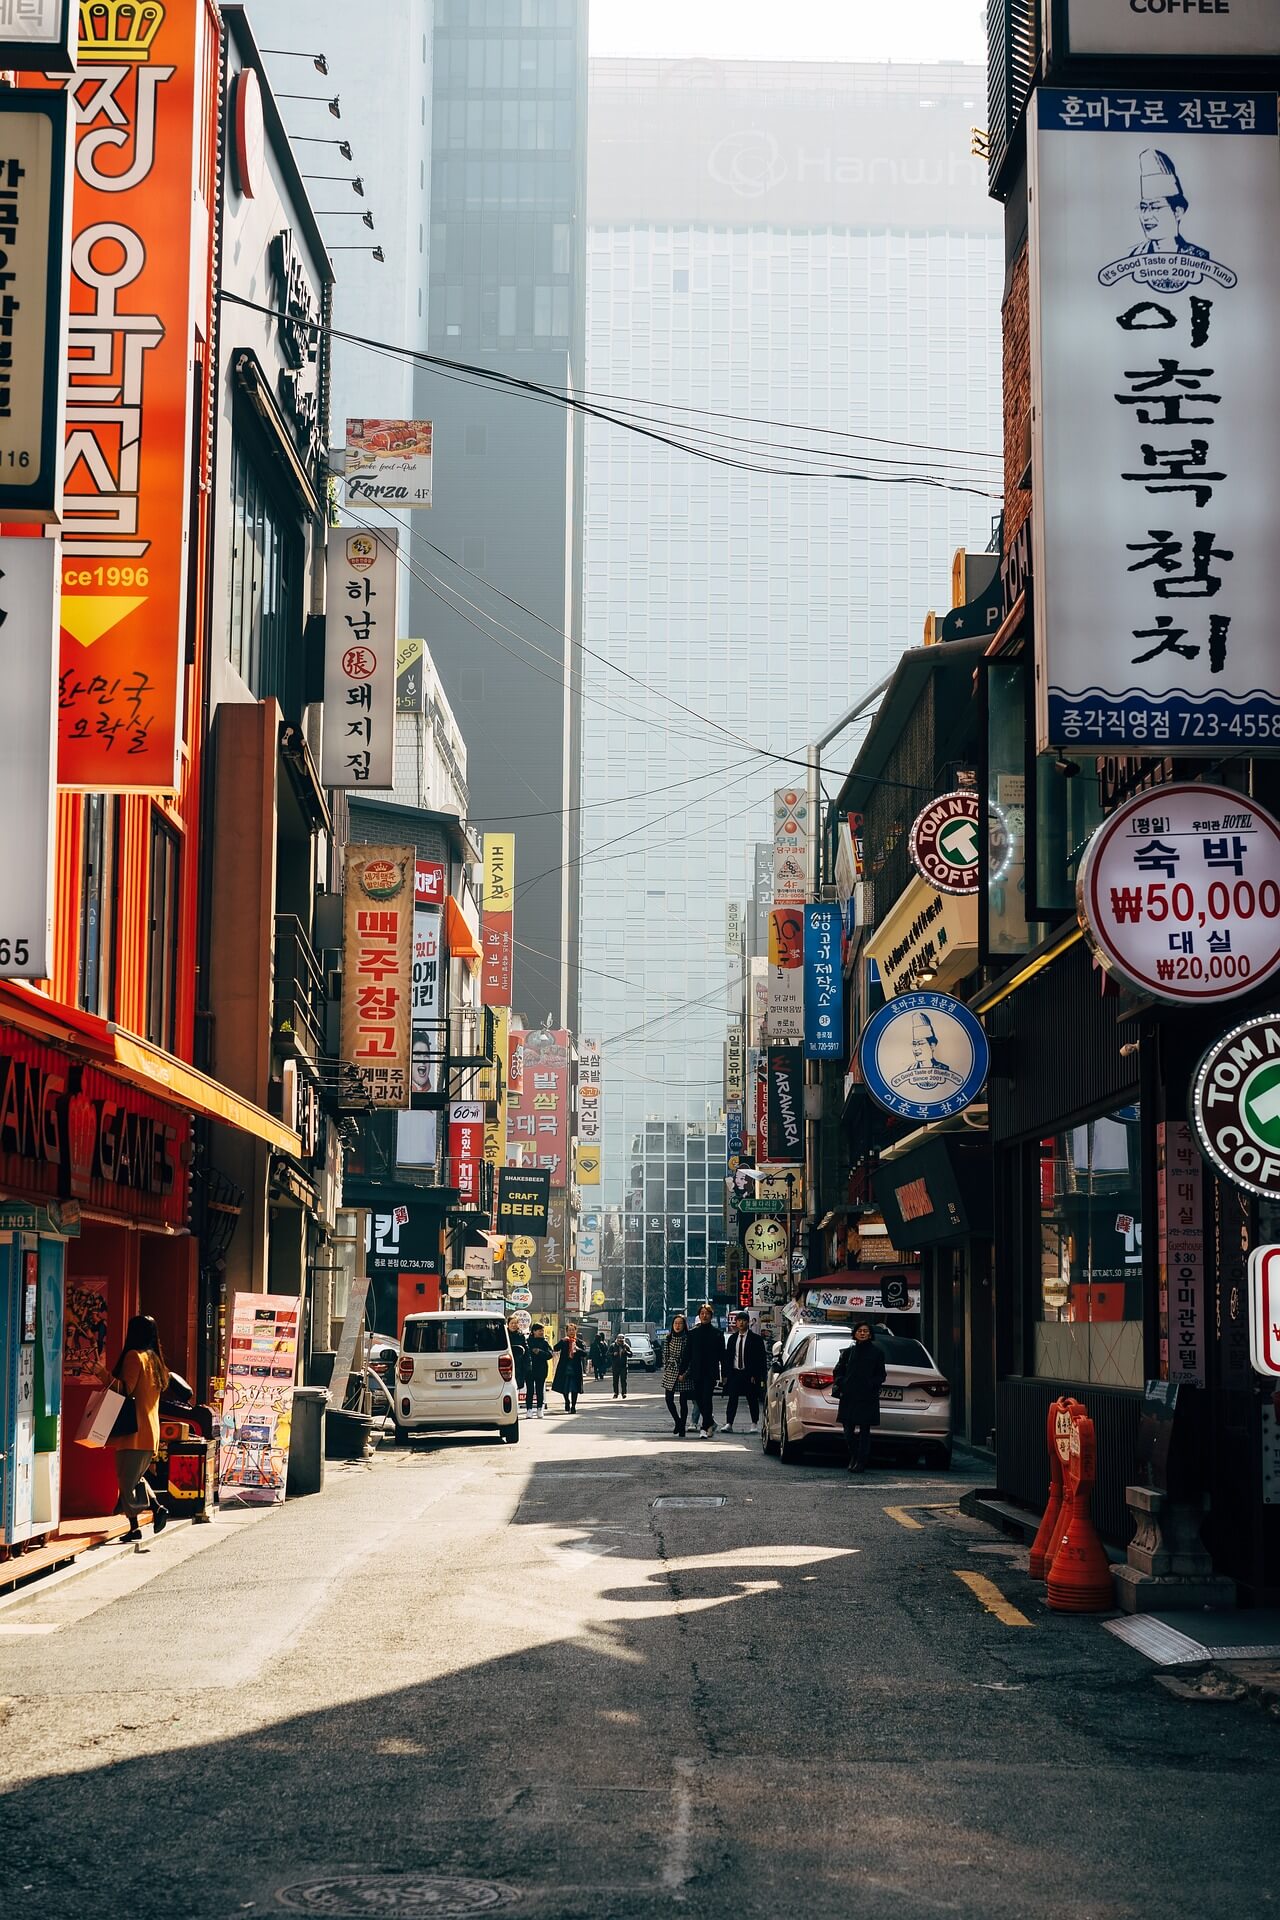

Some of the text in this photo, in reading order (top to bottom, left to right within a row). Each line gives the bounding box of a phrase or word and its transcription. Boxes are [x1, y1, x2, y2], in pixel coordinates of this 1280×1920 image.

[1130, 0, 1230, 14] COFFEE
[1058, 96, 1256, 130] 혼마구로 전문점
[797, 148, 987, 185] Hanwh
[1102, 256, 1232, 283] It's Good Taste of Bluefin Tuna
[1140, 268, 1196, 279] Since 2001
[379, 463, 395, 471] food
[349, 475, 429, 499] Forza 4F
[61, 567, 149, 587] ce1996
[68, 712, 154, 754] 오락실
[1061, 710, 1280, 739] 종각직영점 723-4558
[1192, 814, 1253, 831] 우미관 HOTEL
[364, 871, 396, 881] 세계맥주
[414, 941, 437, 958] 있다
[1156, 955, 1250, 983] ₩20,000
[355, 910, 401, 1058] 맥주창고
[890, 997, 957, 1013] 혼마구로 전문점
[579, 1055, 600, 1067] 보쌈
[728, 1035, 741, 1087] 일본유학
[357, 1068, 404, 1083] 계맥주
[579, 1070, 600, 1083] 족발
[581, 1098, 600, 1136] 보신탕
[99, 1100, 177, 1196] GAMES
[461, 1127, 472, 1160] 맛있는
[509, 1192, 539, 1201] CRAFT
[501, 1203, 545, 1216] BEER
[8, 1215, 34, 1228] NO.1
[746, 1238, 786, 1252] 국자비어
[1169, 1241, 1203, 1250] Guesthouse
[374, 1259, 435, 1268] 종로 본점 02.734.7788
[1176, 1266, 1197, 1370] 우미관호텔
[455, 1371, 474, 1379] 8126
